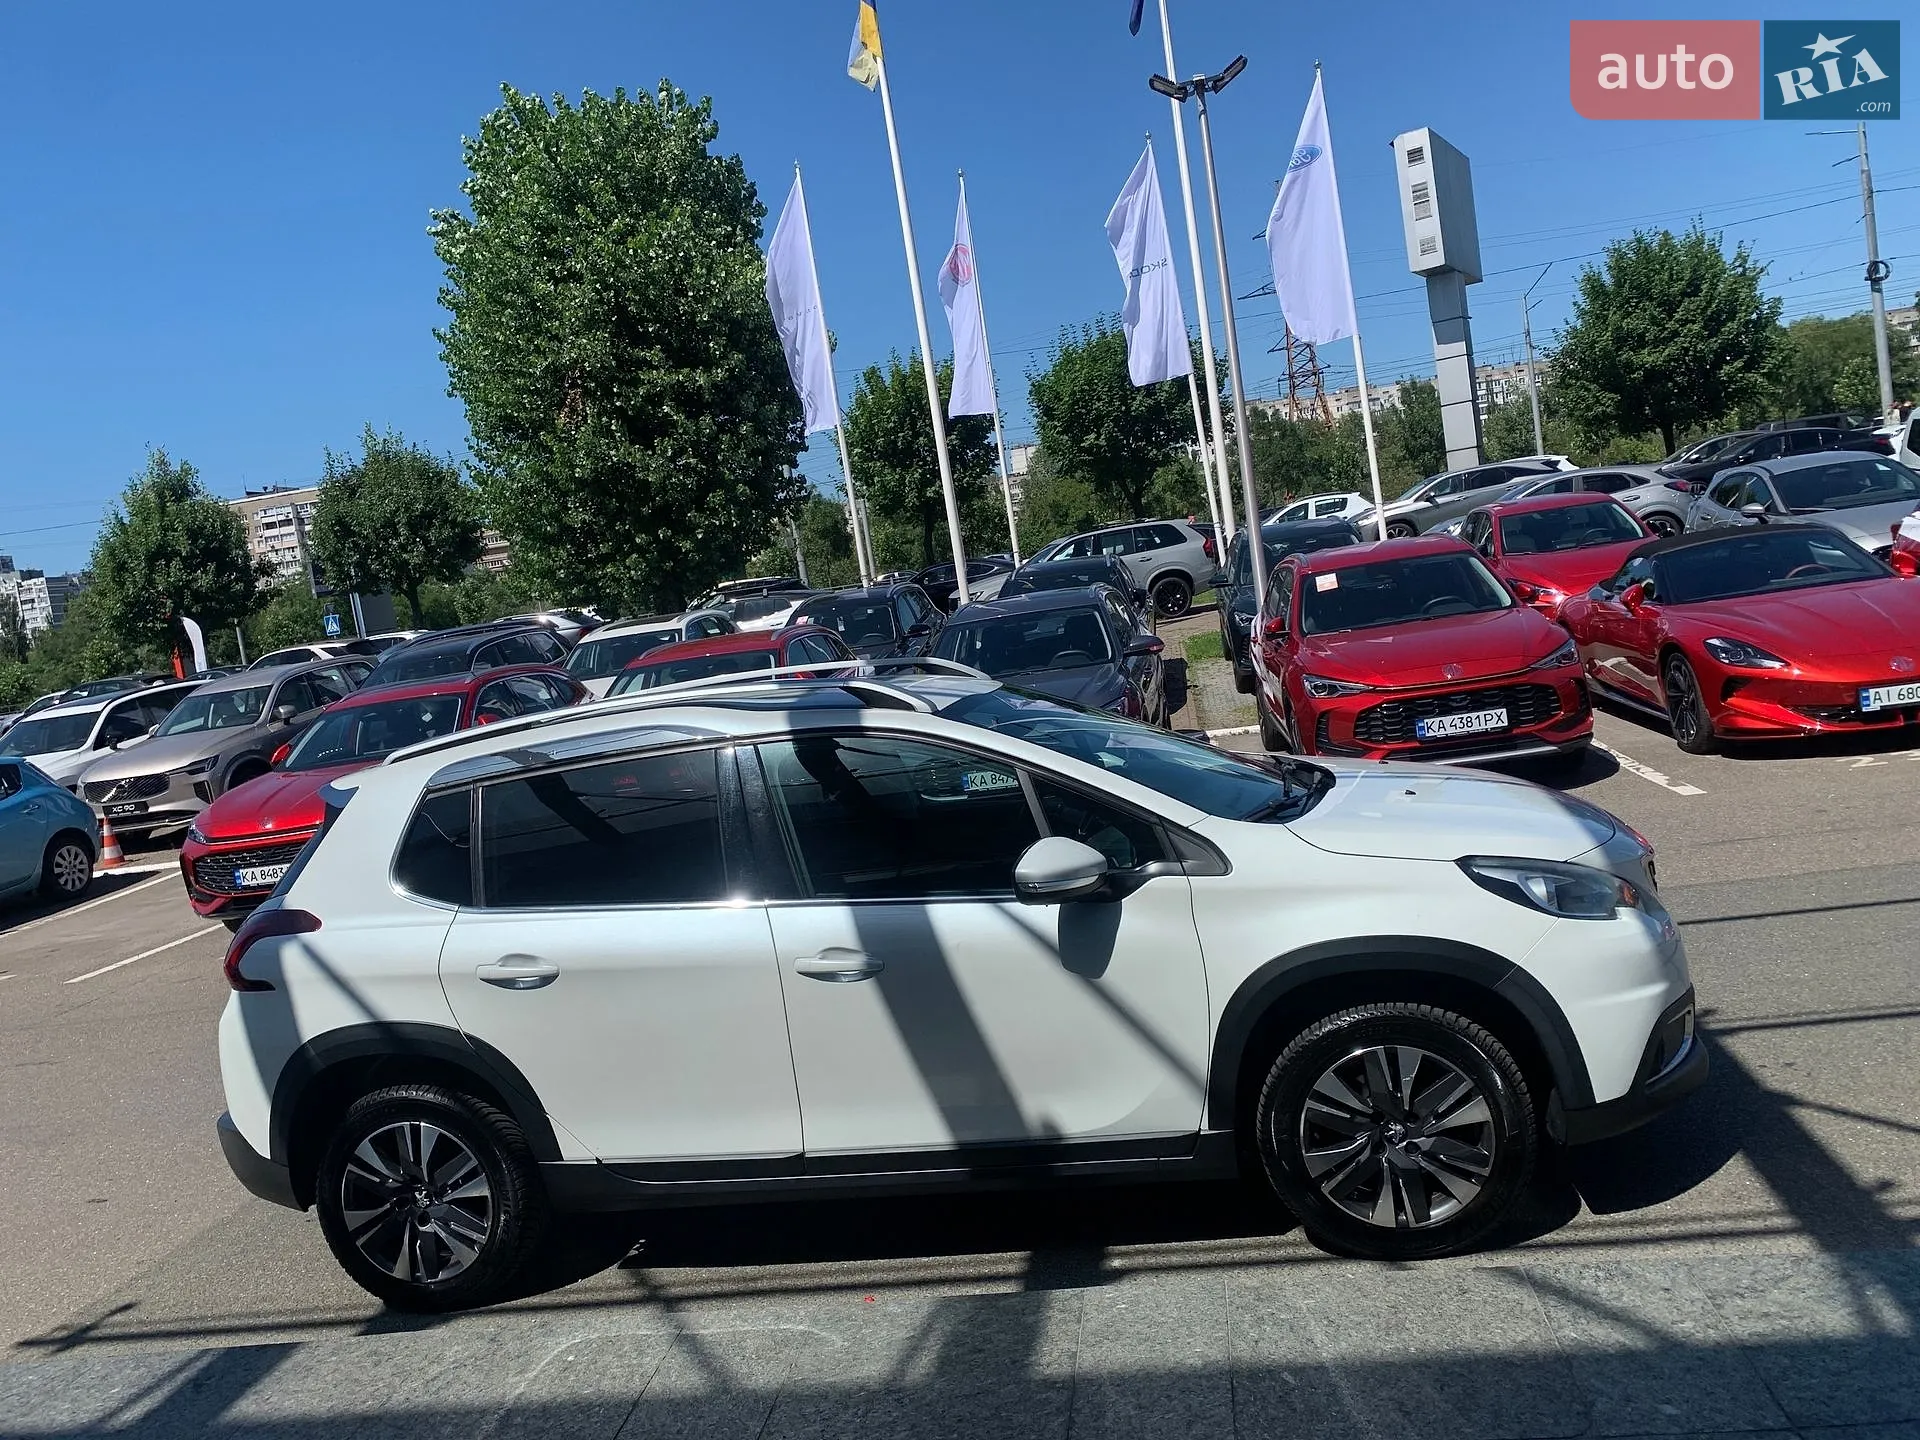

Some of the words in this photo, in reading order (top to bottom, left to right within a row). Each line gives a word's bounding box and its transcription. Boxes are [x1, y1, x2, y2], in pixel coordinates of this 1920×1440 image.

[1872, 689, 1892, 705] AI
[1425, 719, 1447, 734] KA
[1449, 714, 1482, 731] 4381
[1482, 711, 1505, 727] PX
[969, 774, 988, 787] KA
[241, 870, 259, 882] KA
